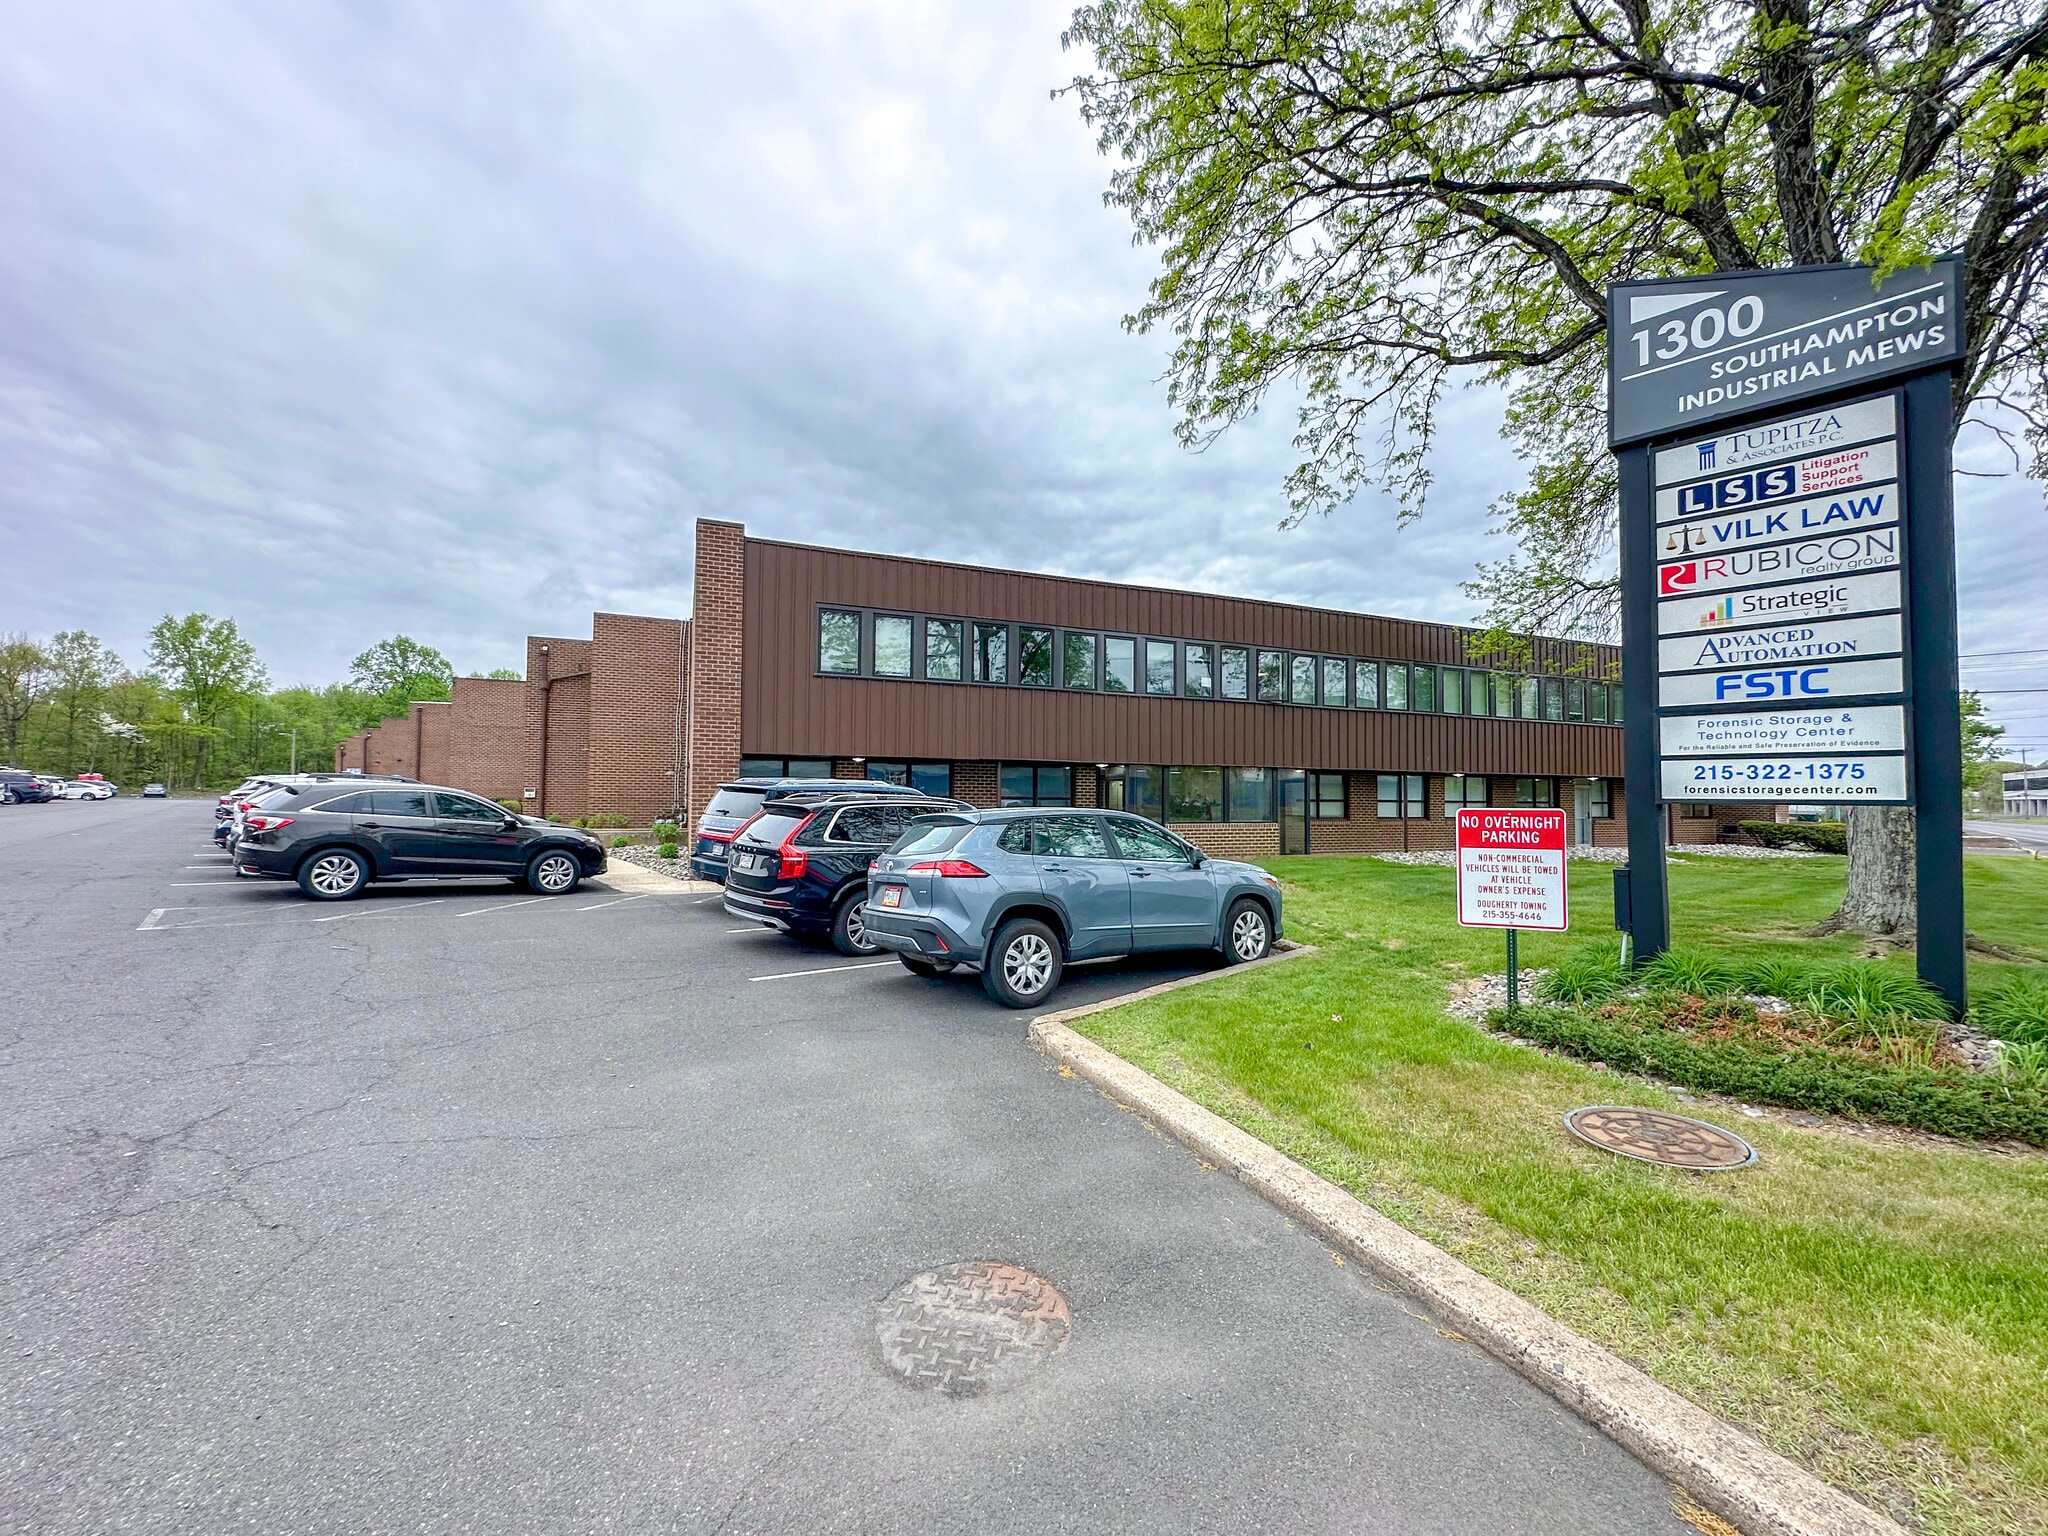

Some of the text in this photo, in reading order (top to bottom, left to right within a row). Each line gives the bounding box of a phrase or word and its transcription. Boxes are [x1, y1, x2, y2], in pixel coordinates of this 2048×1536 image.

[1630, 295, 1764, 367] 1300
[1710, 295, 1945, 380] SOUTHAMPTON
[1679, 325, 1946, 413] INDUSTRIAL MEWS
[1726, 415, 1843, 453] TUPITZA
[1726, 431, 1844, 465] & ASSOCIATES P.C.
[1802, 450, 1869, 471] Litigation
[1802, 463, 1859, 483] Support
[1802, 473, 1863, 492] Services
[1712, 494, 1884, 542] VILK LAW
[1704, 530, 1894, 580] RUBICON
[1801, 554, 1895, 575] realty group
[1742, 585, 1848, 613] Strategic
[1803, 606, 1848, 616] VIEW
[1716, 667, 1829, 700] FSTC
[1697, 713, 1852, 728] Forensic Storage &
[1697, 727, 1855, 741] Technology Center
[1775, 740, 1826, 748] Preservation
[1840, 739, 1880, 747] Evidence
[1694, 763, 1865, 781] 215-322-1375
[1684, 785, 1878, 795] forensicstoragecenter.com
[1461, 816, 1560, 829] NO OVERNIGHT
[1481, 830, 1540, 843] PARKING
[1478, 853, 1544, 864] NON-COMMERCIAL
[1466, 864, 1558, 874] VEHICLES WILL BE TOWED
[1491, 875, 1532, 884] AT VEHICLE
[1477, 885, 1546, 896] OWNER'S EXPENSE
[1477, 899, 1547, 910] DOUGHERTY TOWING
[1482, 910, 1542, 920] 215-355-4646
